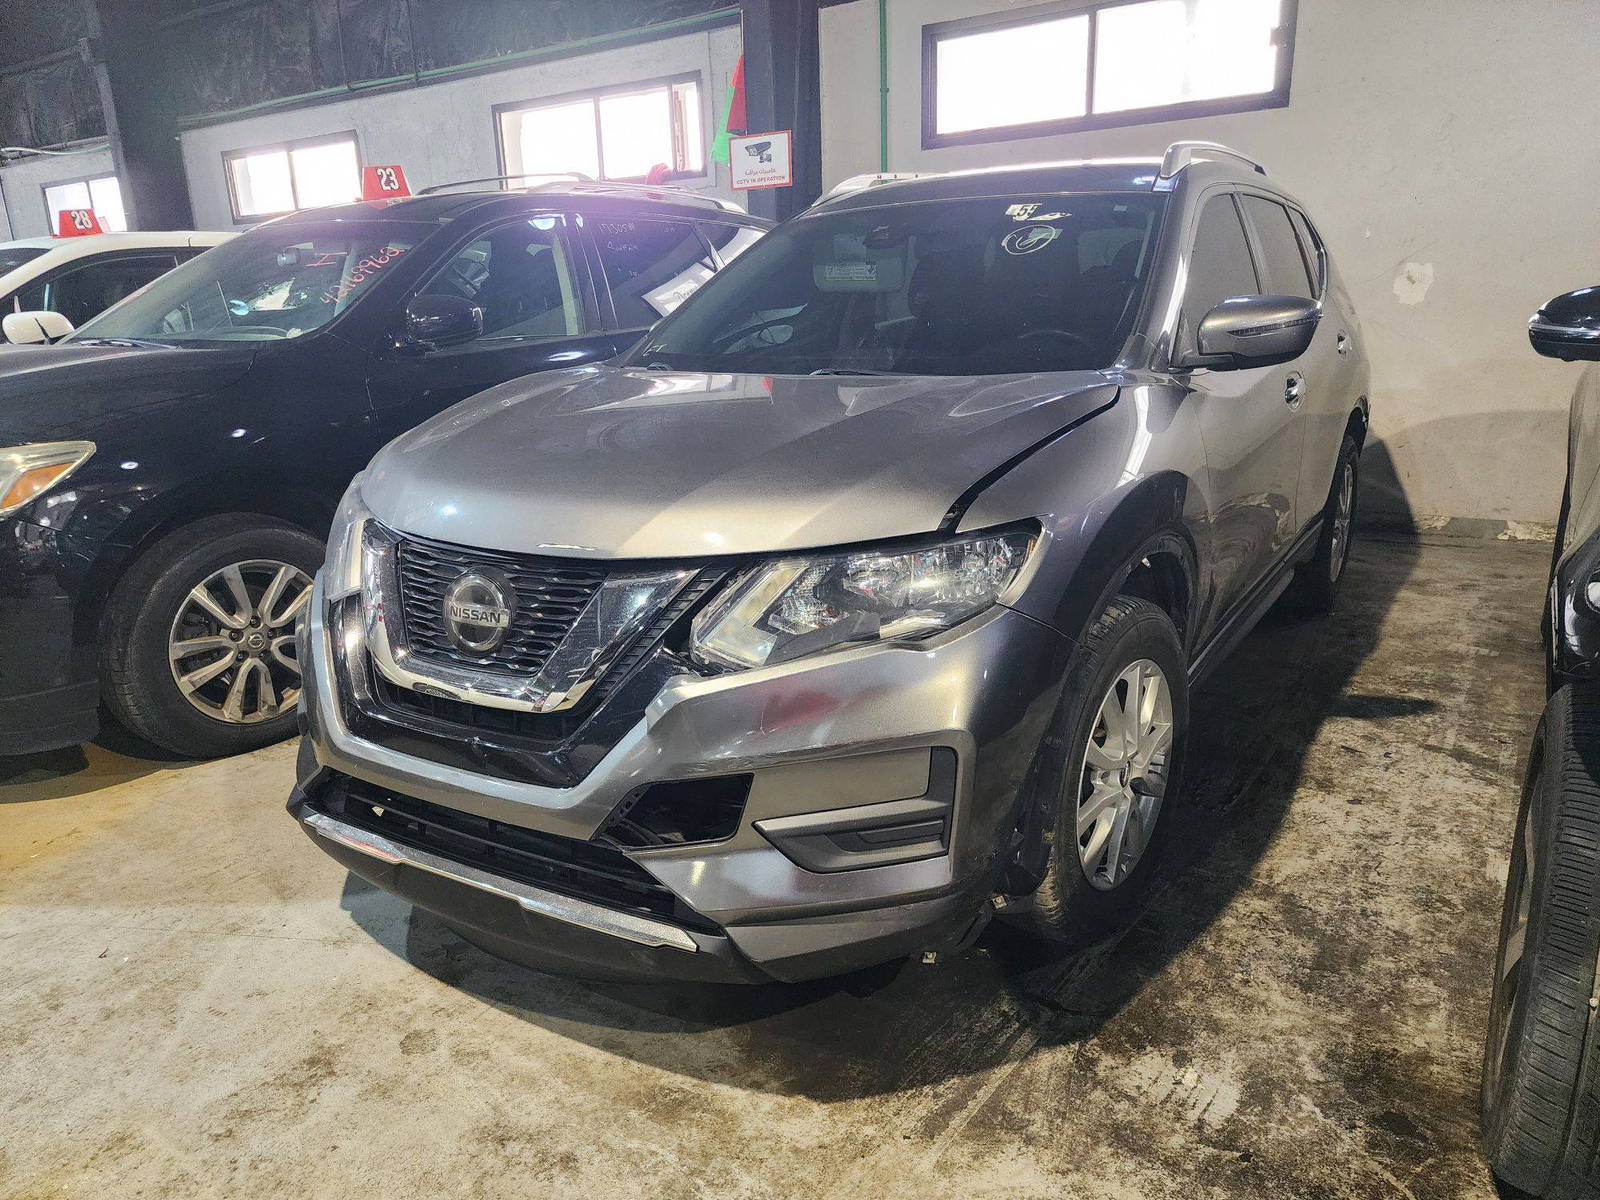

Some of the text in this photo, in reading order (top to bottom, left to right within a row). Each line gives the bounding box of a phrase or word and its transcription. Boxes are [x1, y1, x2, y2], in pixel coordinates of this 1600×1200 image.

[376, 167, 400, 191] 23
[757, 175, 785, 183] OPERATION
[70, 210, 93, 230] 28
[450, 605, 501, 624] NISSAN
